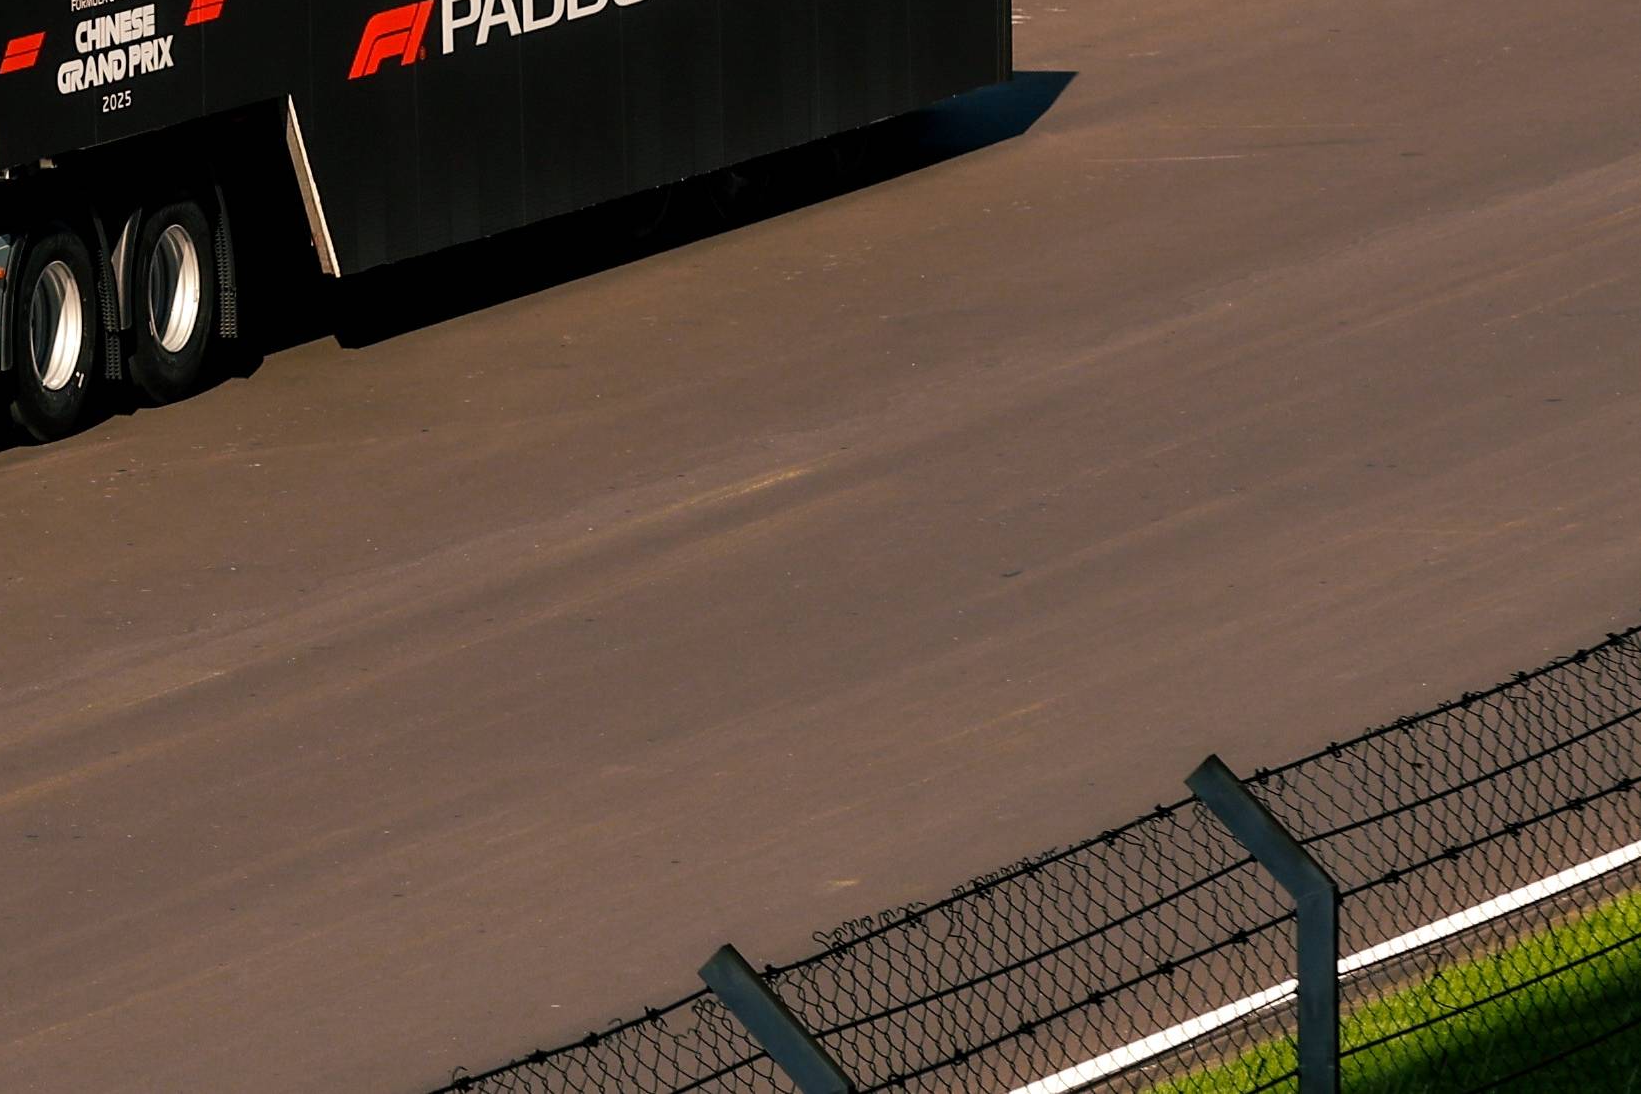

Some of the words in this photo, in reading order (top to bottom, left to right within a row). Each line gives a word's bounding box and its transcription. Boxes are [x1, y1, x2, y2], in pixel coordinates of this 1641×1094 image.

[75, 3, 156, 54] CHINESE
[57, 48, 127, 95] GRAND
[128, 34, 175, 78] PRIX
[102, 89, 133, 113] 2025
